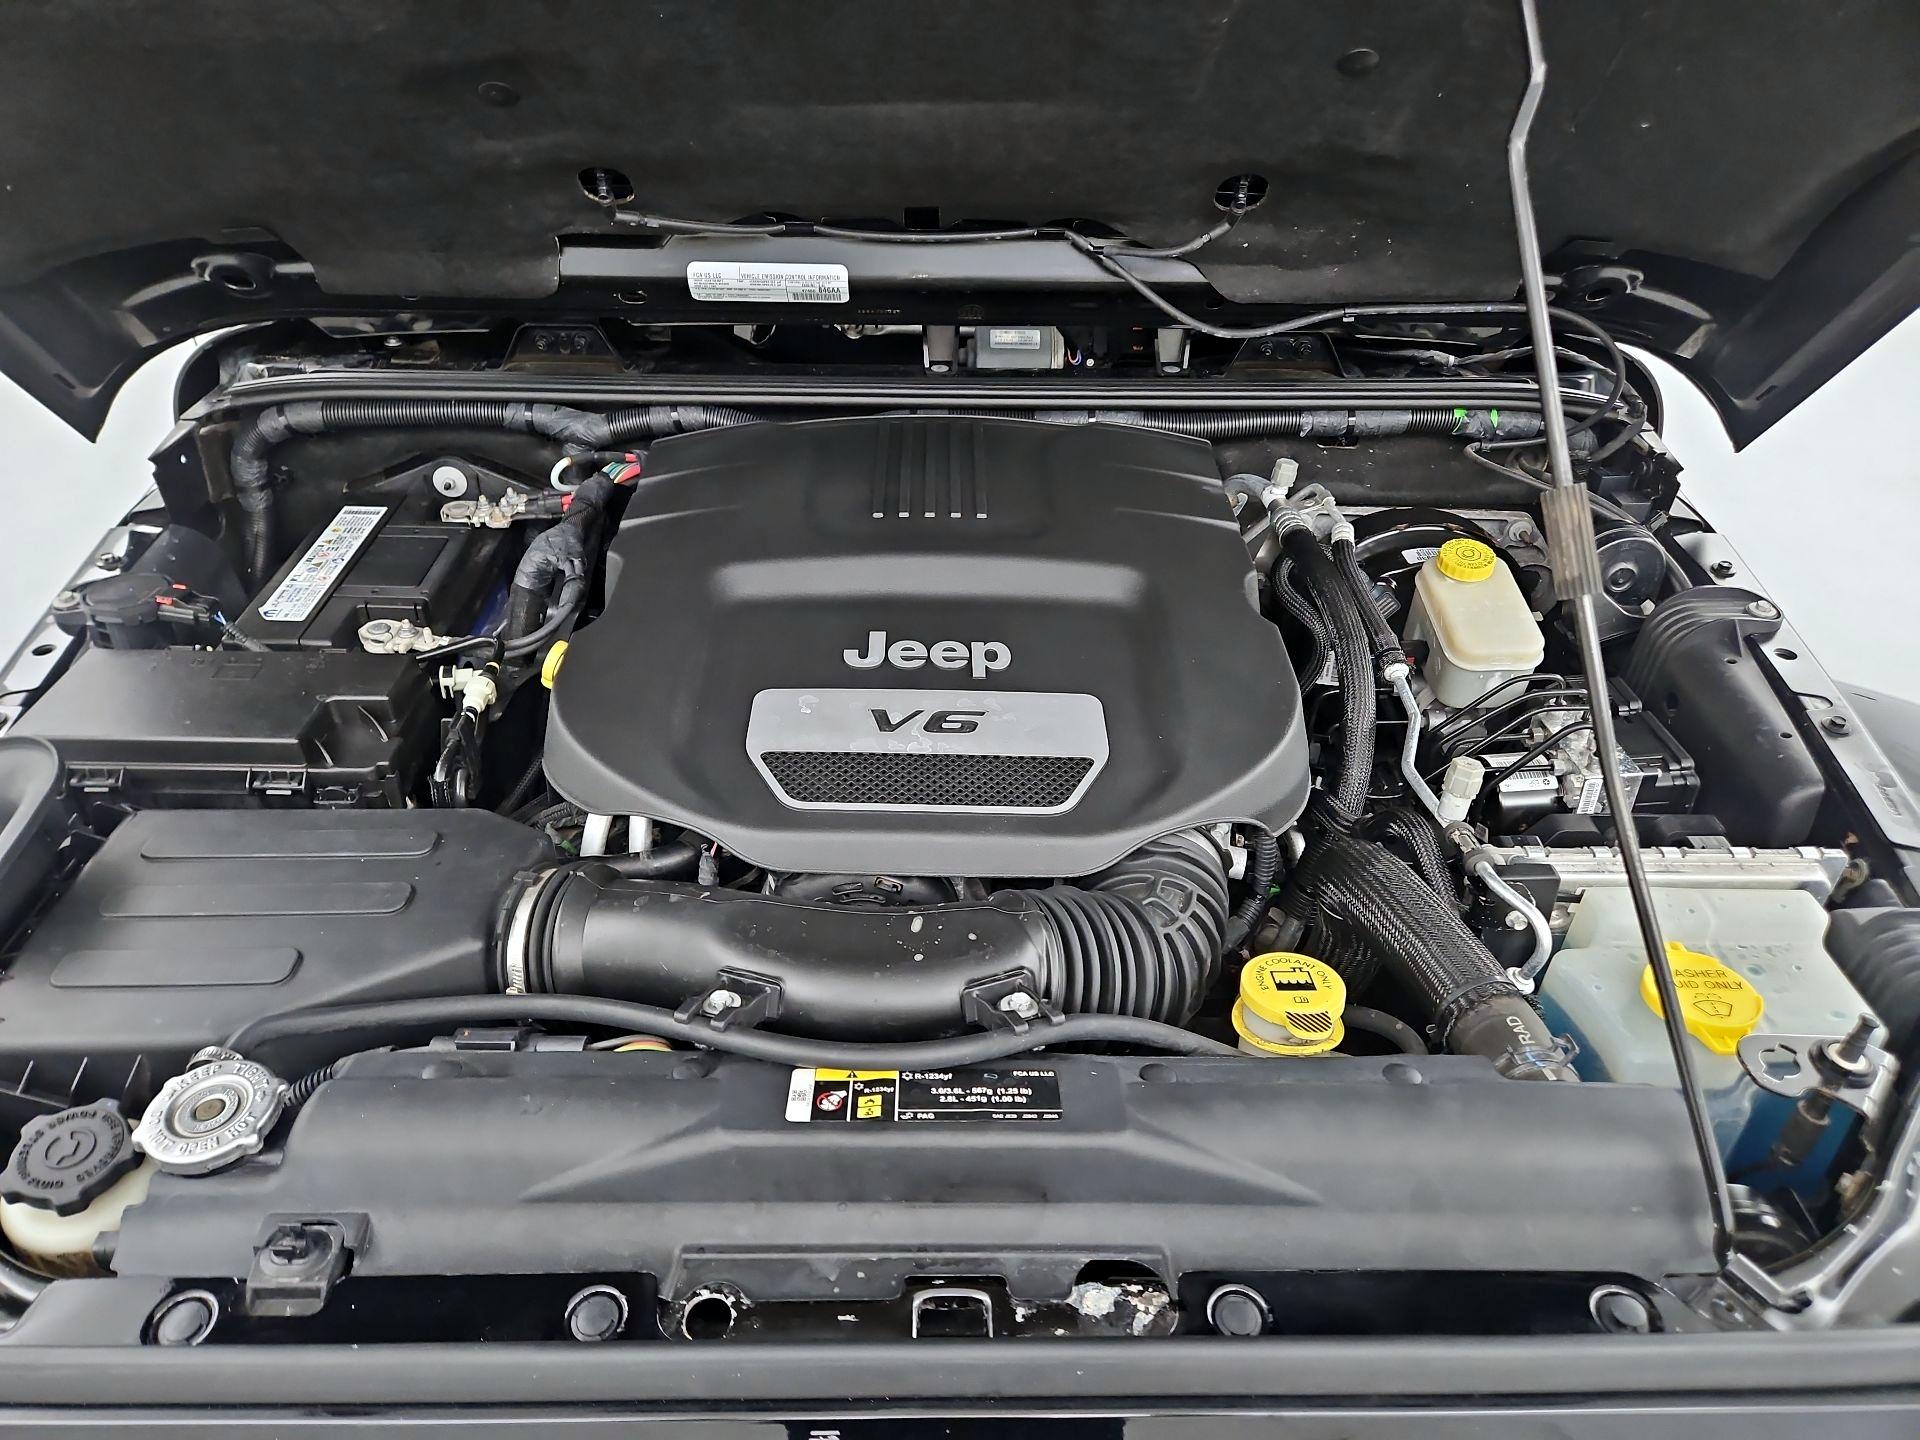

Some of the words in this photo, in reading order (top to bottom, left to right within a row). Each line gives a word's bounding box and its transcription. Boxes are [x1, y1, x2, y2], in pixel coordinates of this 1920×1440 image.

[842, 630, 1013, 679] Jeep
[868, 708, 989, 734] V6
[1255, 964, 1270, 992] ENGINE
[1265, 957, 1316, 970] COOLANT
[1316, 970, 1332, 990] ONLY
[1674, 968, 1728, 978] ASHER
[1674, 980, 1699, 989] UID
[1704, 980, 1744, 990] ONLY
[1505, 1015, 1536, 1045] RAD
[176, 1064, 222, 1089] KEEP
[232, 1062, 270, 1090] TIGHT
[914, 1072, 953, 1081] R-1234yf
[965, 1095, 988, 1103] 451g
[991, 1095, 1014, 1104] (1.00
[1014, 1096, 1027, 1104] lb)
[1020, 1087, 1033, 1096] lb)
[178, 1135, 221, 1156] OPEN
[225, 1112, 258, 1139] HOT
